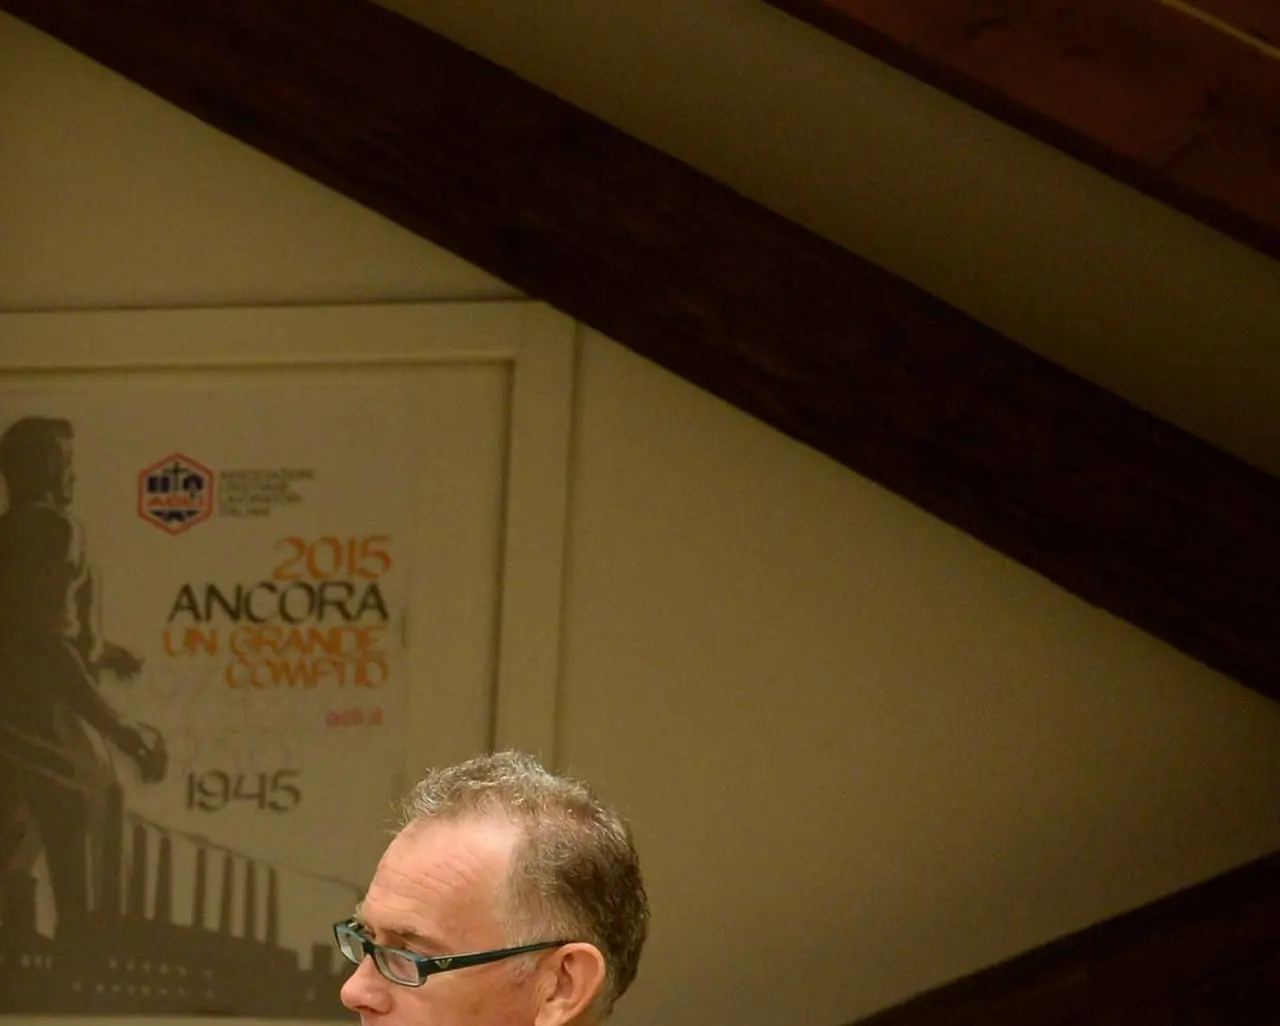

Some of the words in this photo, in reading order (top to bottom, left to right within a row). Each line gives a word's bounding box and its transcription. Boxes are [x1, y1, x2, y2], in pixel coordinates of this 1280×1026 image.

[272, 535, 392, 580] 2015
[168, 581, 388, 624] ANCORA
[163, 626, 217, 657] UN
[230, 624, 387, 656] GRANDE
[186, 768, 302, 815] 1945
